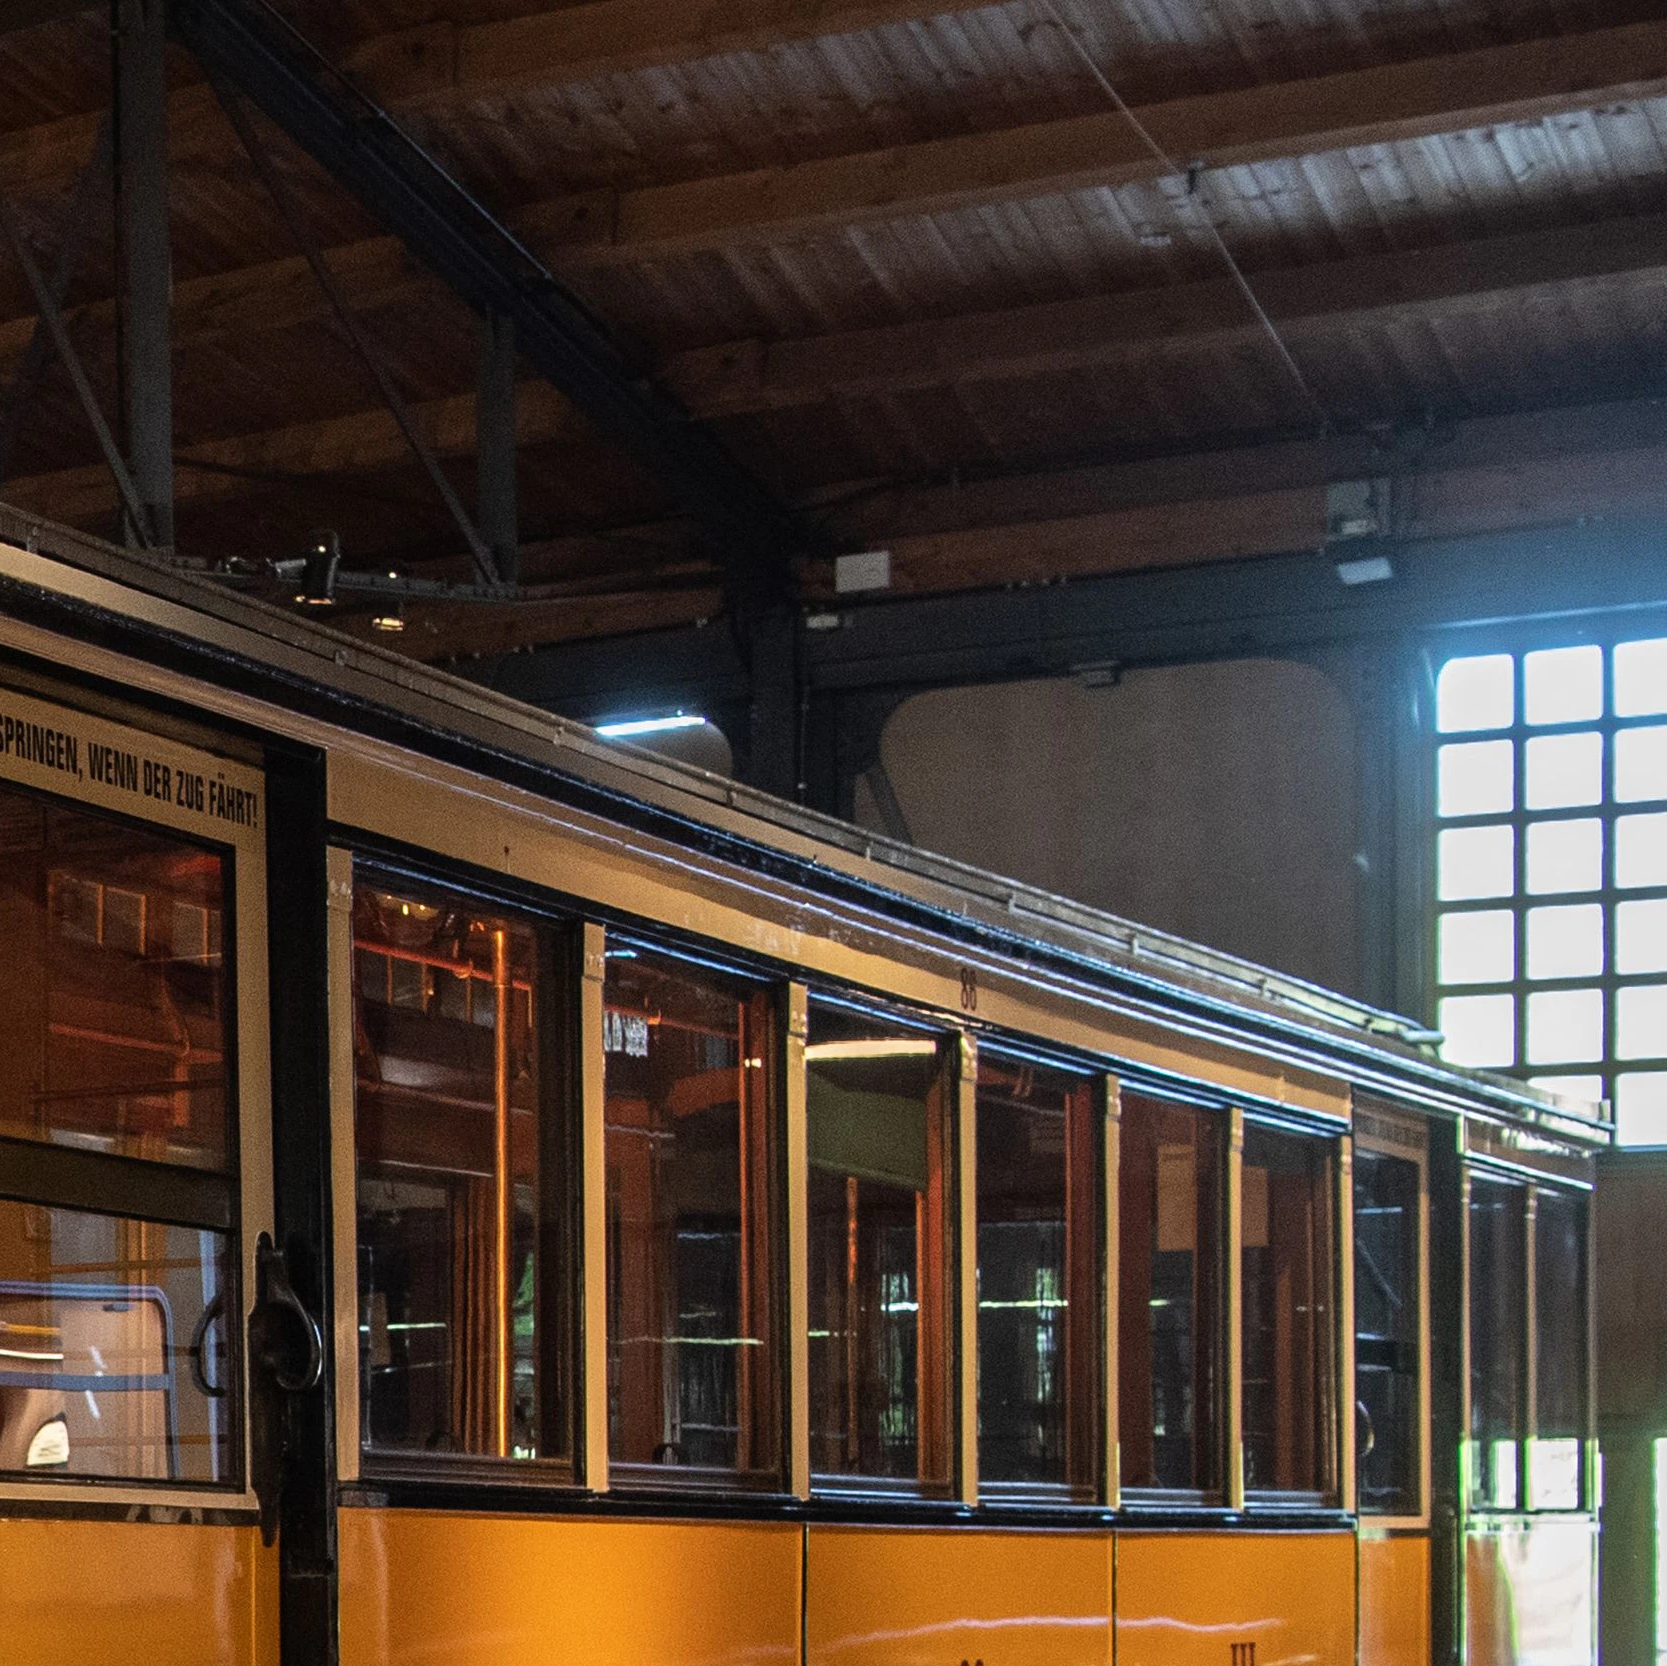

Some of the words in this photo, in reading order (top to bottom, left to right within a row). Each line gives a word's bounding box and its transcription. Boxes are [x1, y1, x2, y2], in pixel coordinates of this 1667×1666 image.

[88, 742, 137, 792] WENN
[143, 759, 171, 802] DER
[176, 770, 204, 813] ZUG
[209, 772, 258, 828] FÄHRT!
